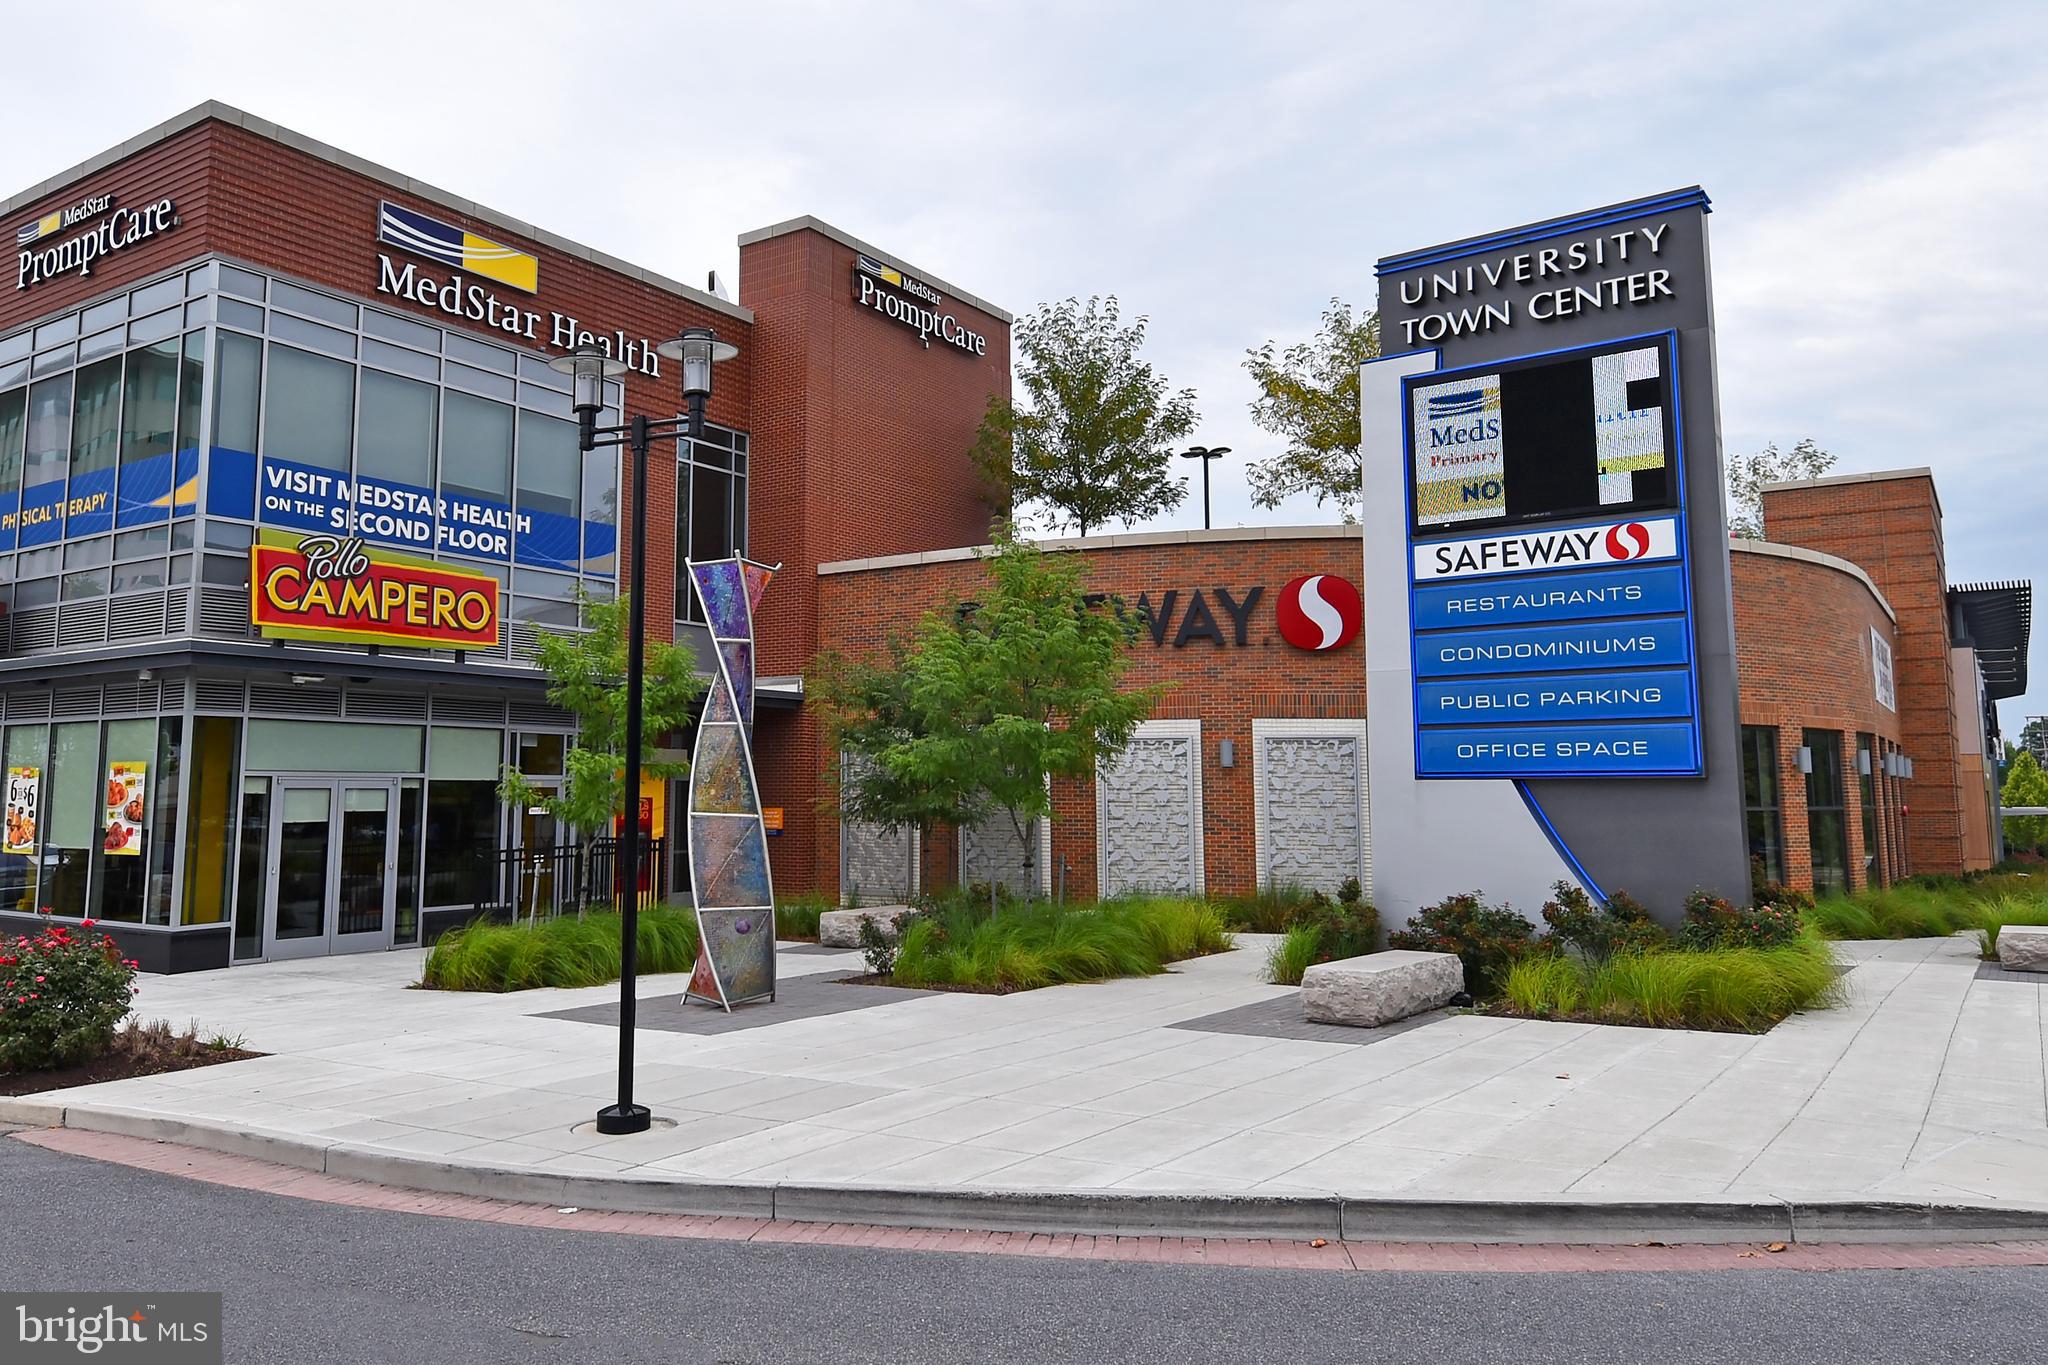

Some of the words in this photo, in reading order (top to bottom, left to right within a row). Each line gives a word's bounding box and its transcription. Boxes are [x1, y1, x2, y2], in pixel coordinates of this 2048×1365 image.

[63, 193, 112, 228] MedStar
[16, 199, 172, 291] PromptCare
[1400, 223, 1669, 305] UNIVERSITY
[902, 276, 942, 306] MedStar
[1400, 300, 1512, 344] TOWN
[1528, 268, 1674, 320] CENTER
[377, 253, 541, 339] MedStar
[551, 311, 661, 378] Health
[859, 274, 986, 356] PromptCare
[1431, 450, 1498, 467] Primary
[266, 465, 332, 497] VISIT
[337, 479, 447, 519] MEDSTAR
[453, 501, 531, 534] HEALTH
[265, 495, 291, 514] ON
[294, 500, 324, 518] THE
[330, 506, 430, 541] SECOND
[437, 524, 507, 555] FLOOR
[298, 536, 370, 580] Pollo
[1436, 531, 1600, 574] SAFEWAY
[261, 566, 492, 631] CAMPERO
[1447, 585, 1642, 614] RESTAURANTS
[1440, 636, 1656, 662] CONDOMINIUMS
[1441, 692, 1530, 710] PUBLIC
[1540, 687, 1662, 706] PARKING
[1457, 743, 1547, 758] OFFICE
[1556, 740, 1649, 756] SPACE
[10, 779, 18, 802] 6
